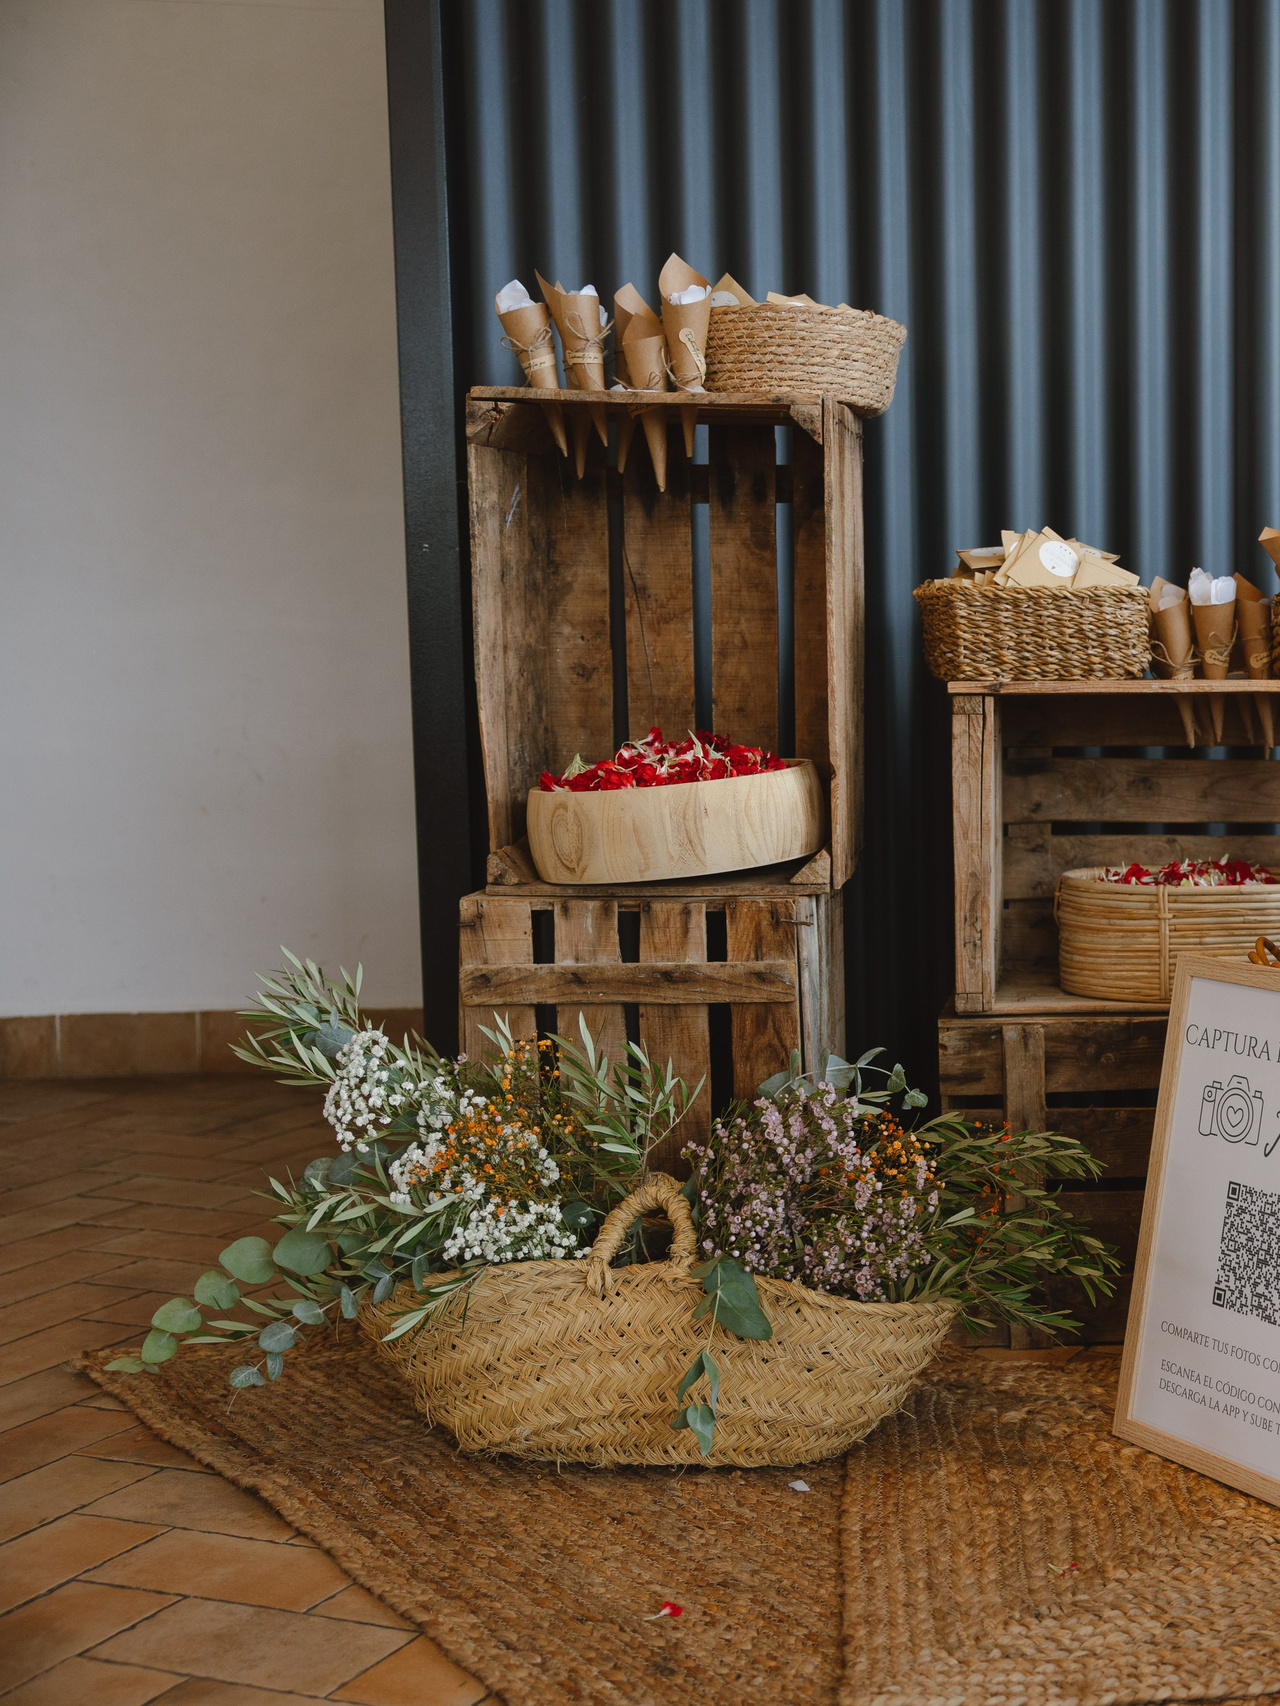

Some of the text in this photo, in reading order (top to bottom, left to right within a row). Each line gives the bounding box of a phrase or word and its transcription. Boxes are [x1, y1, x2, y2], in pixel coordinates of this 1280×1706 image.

[1186, 1024, 1271, 1061] CAPTURA
[1161, 1321, 1210, 1348] COMPARTE
[1211, 1338, 1228, 1354] TUS
[1231, 1346, 1261, 1366] FOTOS
[1159, 1378, 1206, 1405] DESCARGA
[1208, 1397, 1221, 1411] LA
[1222, 1404, 1241, 1418] APP
[1241, 1410, 1249, 1422] Y
[1250, 1414, 1273, 1432] SUBE
[1161, 1359, 1201, 1384] ESCANEA
[1203, 1375, 1213, 1389] EL
[1215, 1381, 1256, 1404] CÓDIGO
[1258, 1396, 1280, 1414] CON
